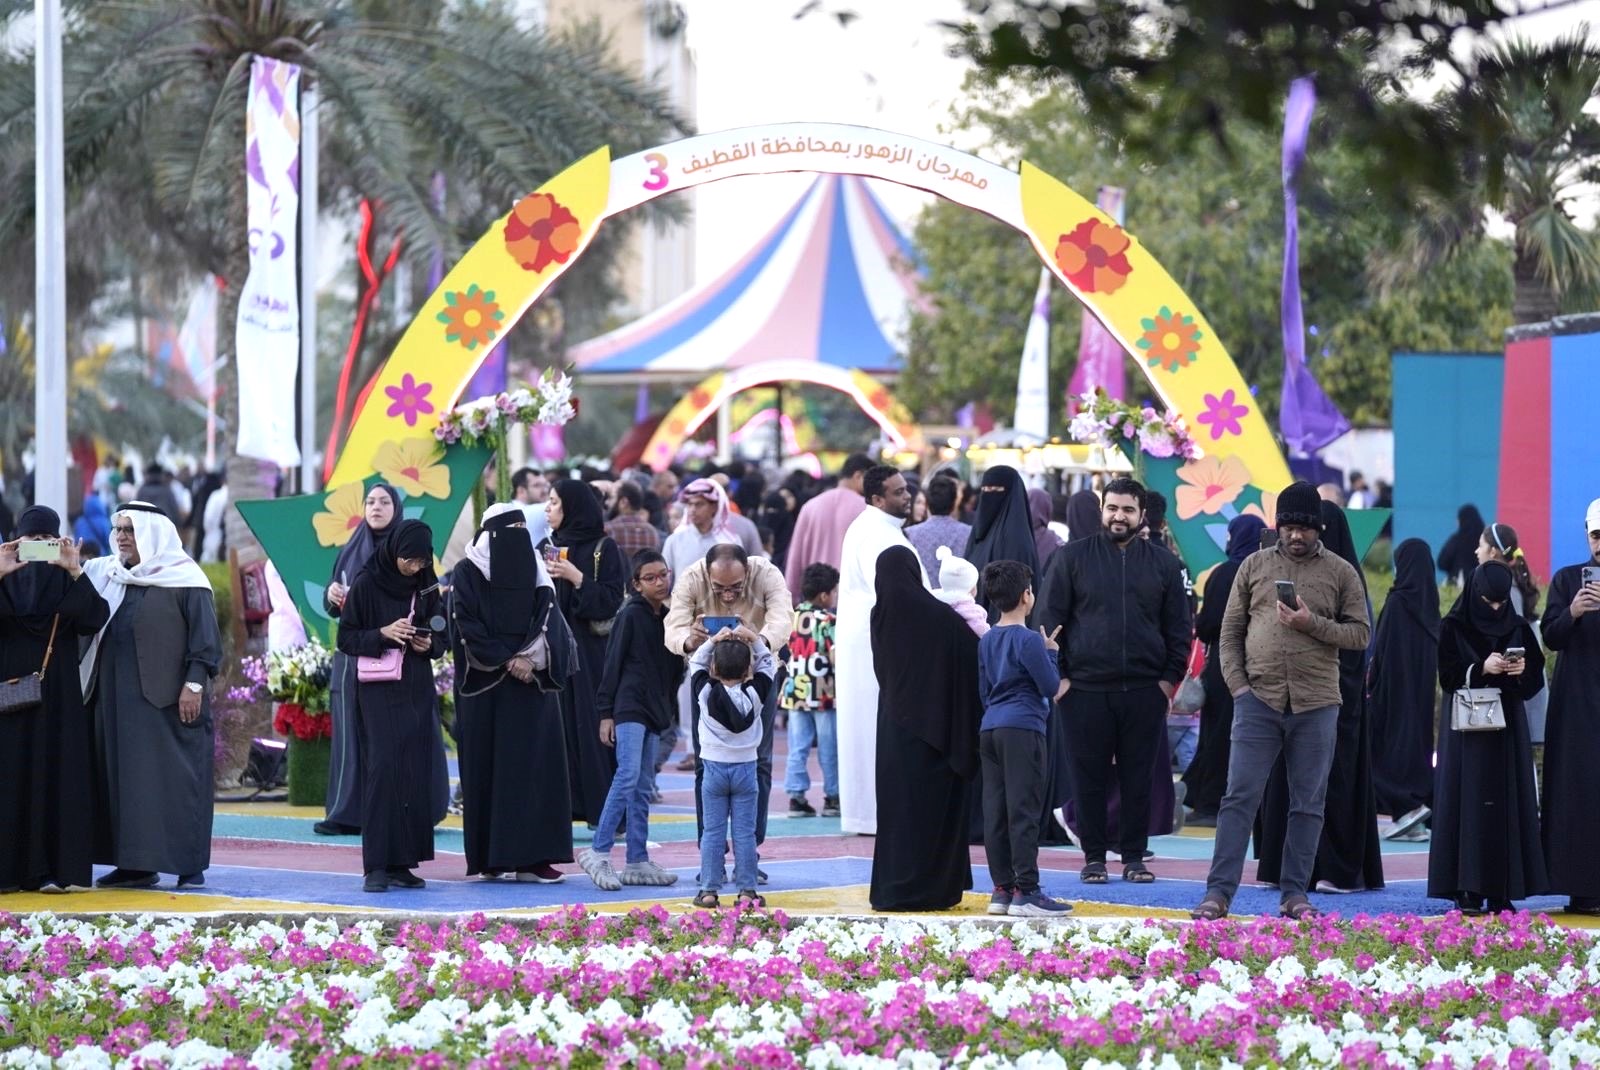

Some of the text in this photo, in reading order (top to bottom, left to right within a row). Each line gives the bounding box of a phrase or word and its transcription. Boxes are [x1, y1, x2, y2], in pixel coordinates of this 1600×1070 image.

[642, 136, 988, 191] مهرجان الزهور بمحافظة القطيف 3
